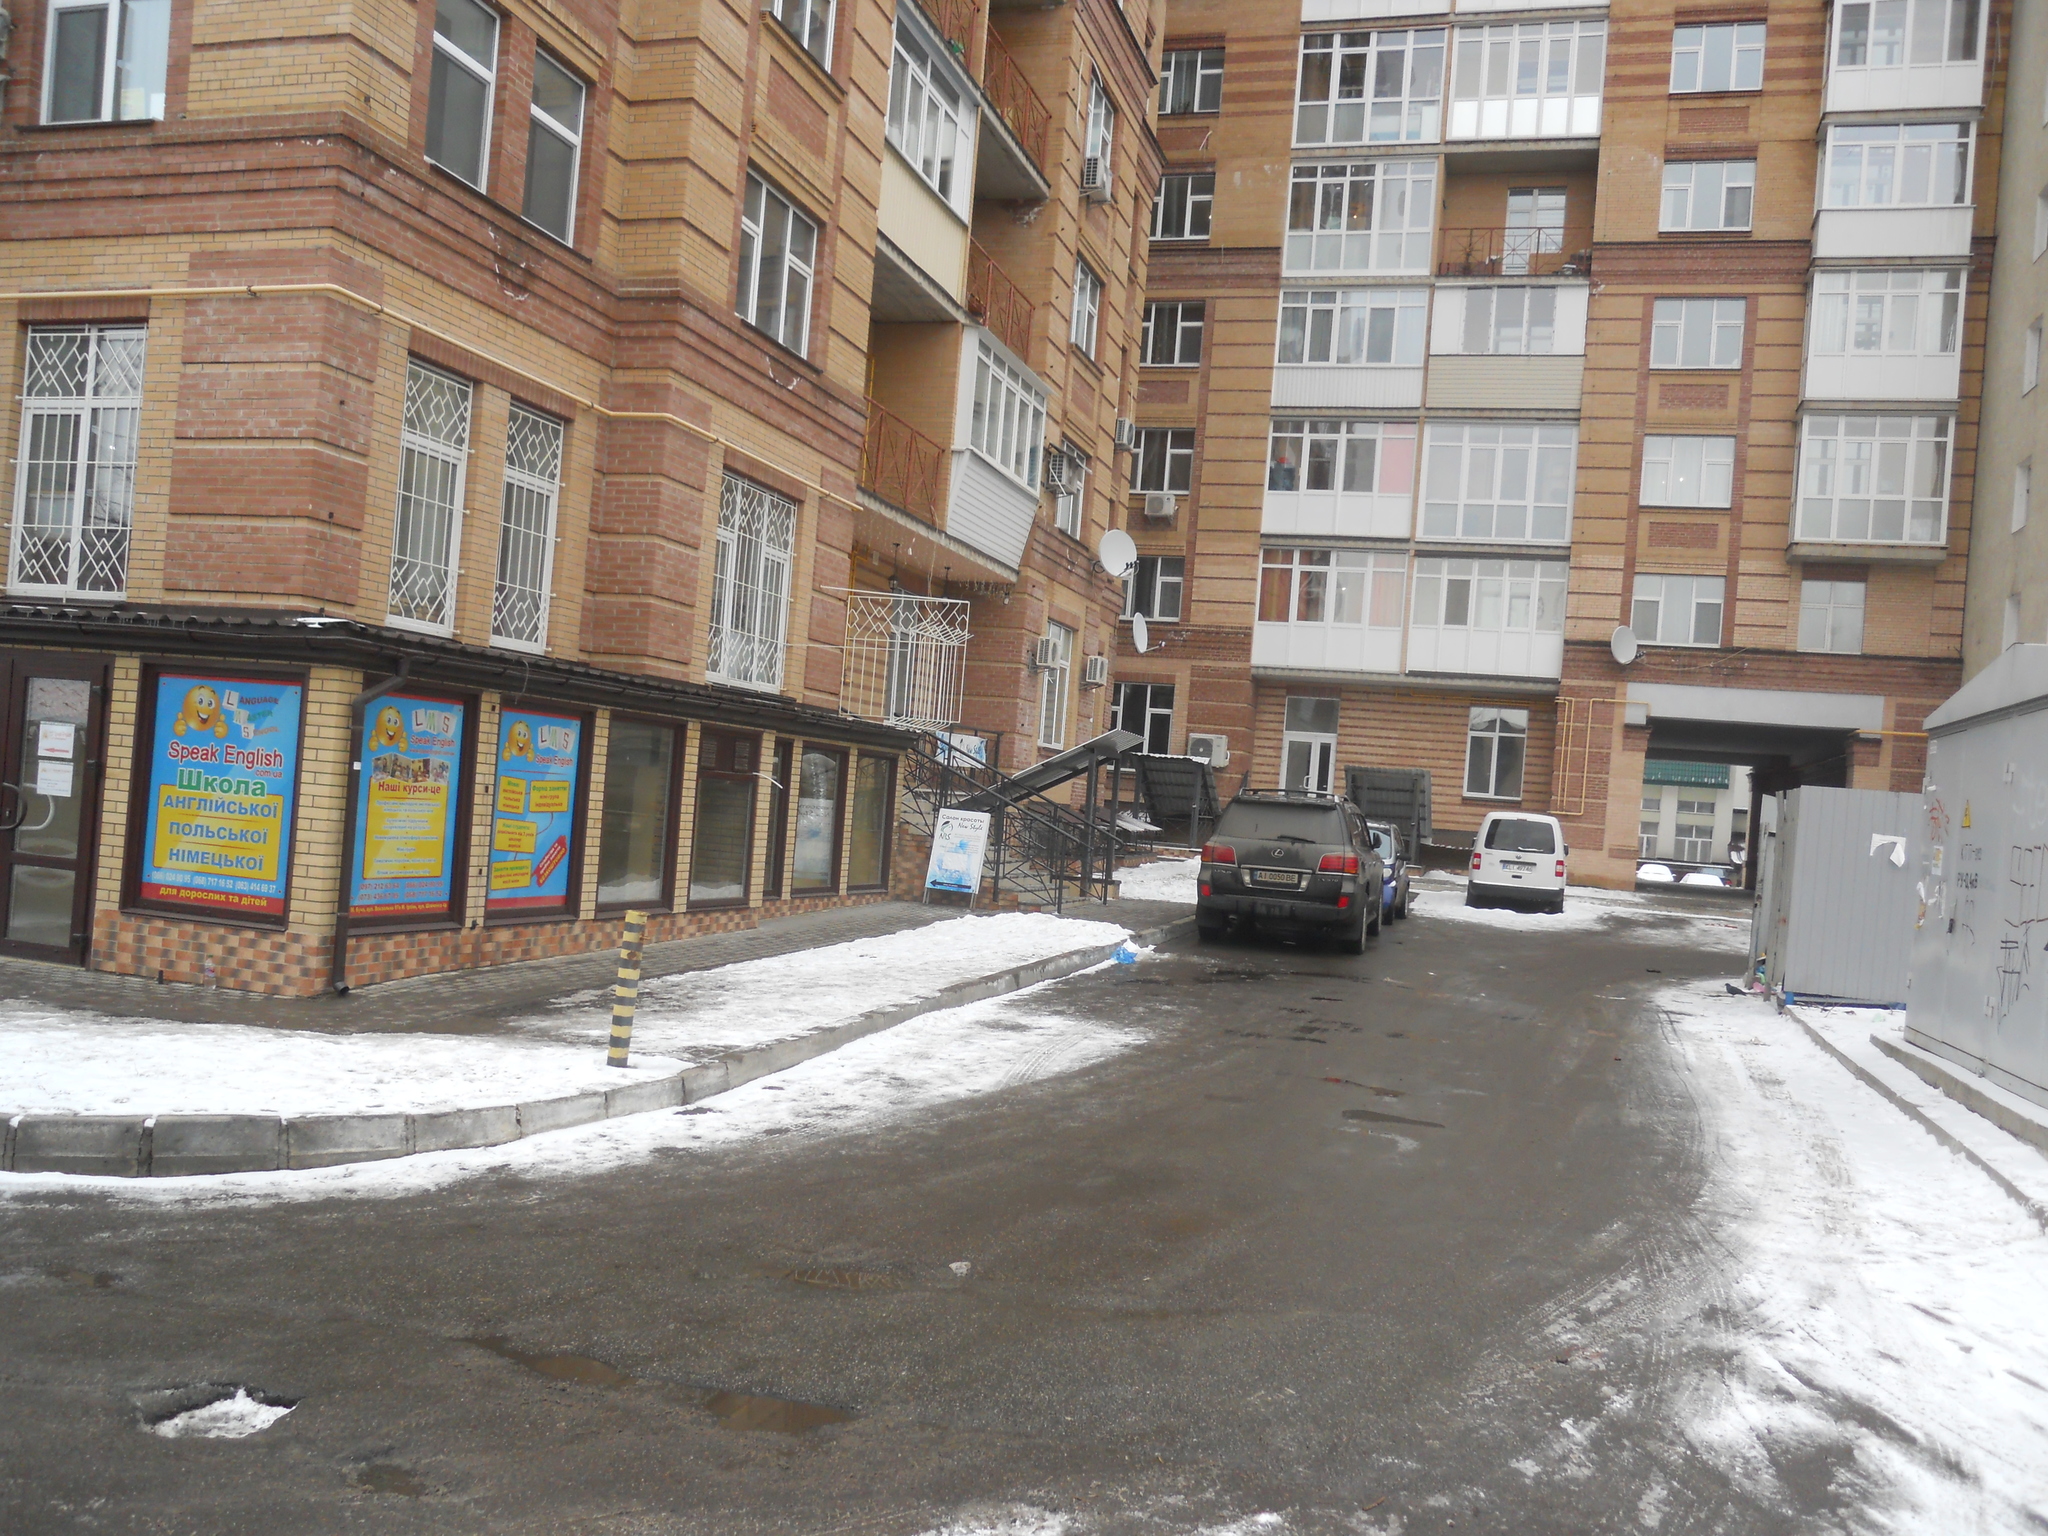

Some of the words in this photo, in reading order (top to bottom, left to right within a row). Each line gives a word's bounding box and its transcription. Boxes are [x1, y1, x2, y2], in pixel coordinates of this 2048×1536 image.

[415, 710, 450, 733] LMS
[410, 735, 430, 747] Speak
[432, 736, 455, 748] English
[168, 741, 219, 764] Speak
[224, 745, 283, 770] English
[536, 753, 552, 764] Speak
[554, 755, 573, 767] English
[177, 768, 267, 797] Школа
[255, 769, 283, 778] com.ua
[378, 781, 400, 792] Наші
[163, 795, 279, 818] АНГЛІЙСЬКОЇ
[169, 822, 268, 844] ПОЛЬСЬКОЇ
[970, 823, 983, 832] Style
[169, 848, 264, 871] НІМЕЦЬКОЇ
[1258, 871, 1266, 879] AI
[1286, 874, 1296, 882] BE
[160, 886, 177, 896] для
[179, 888, 226, 901] дорослих
[229, 895, 239, 903] та
[241, 895, 267, 906] дітей
